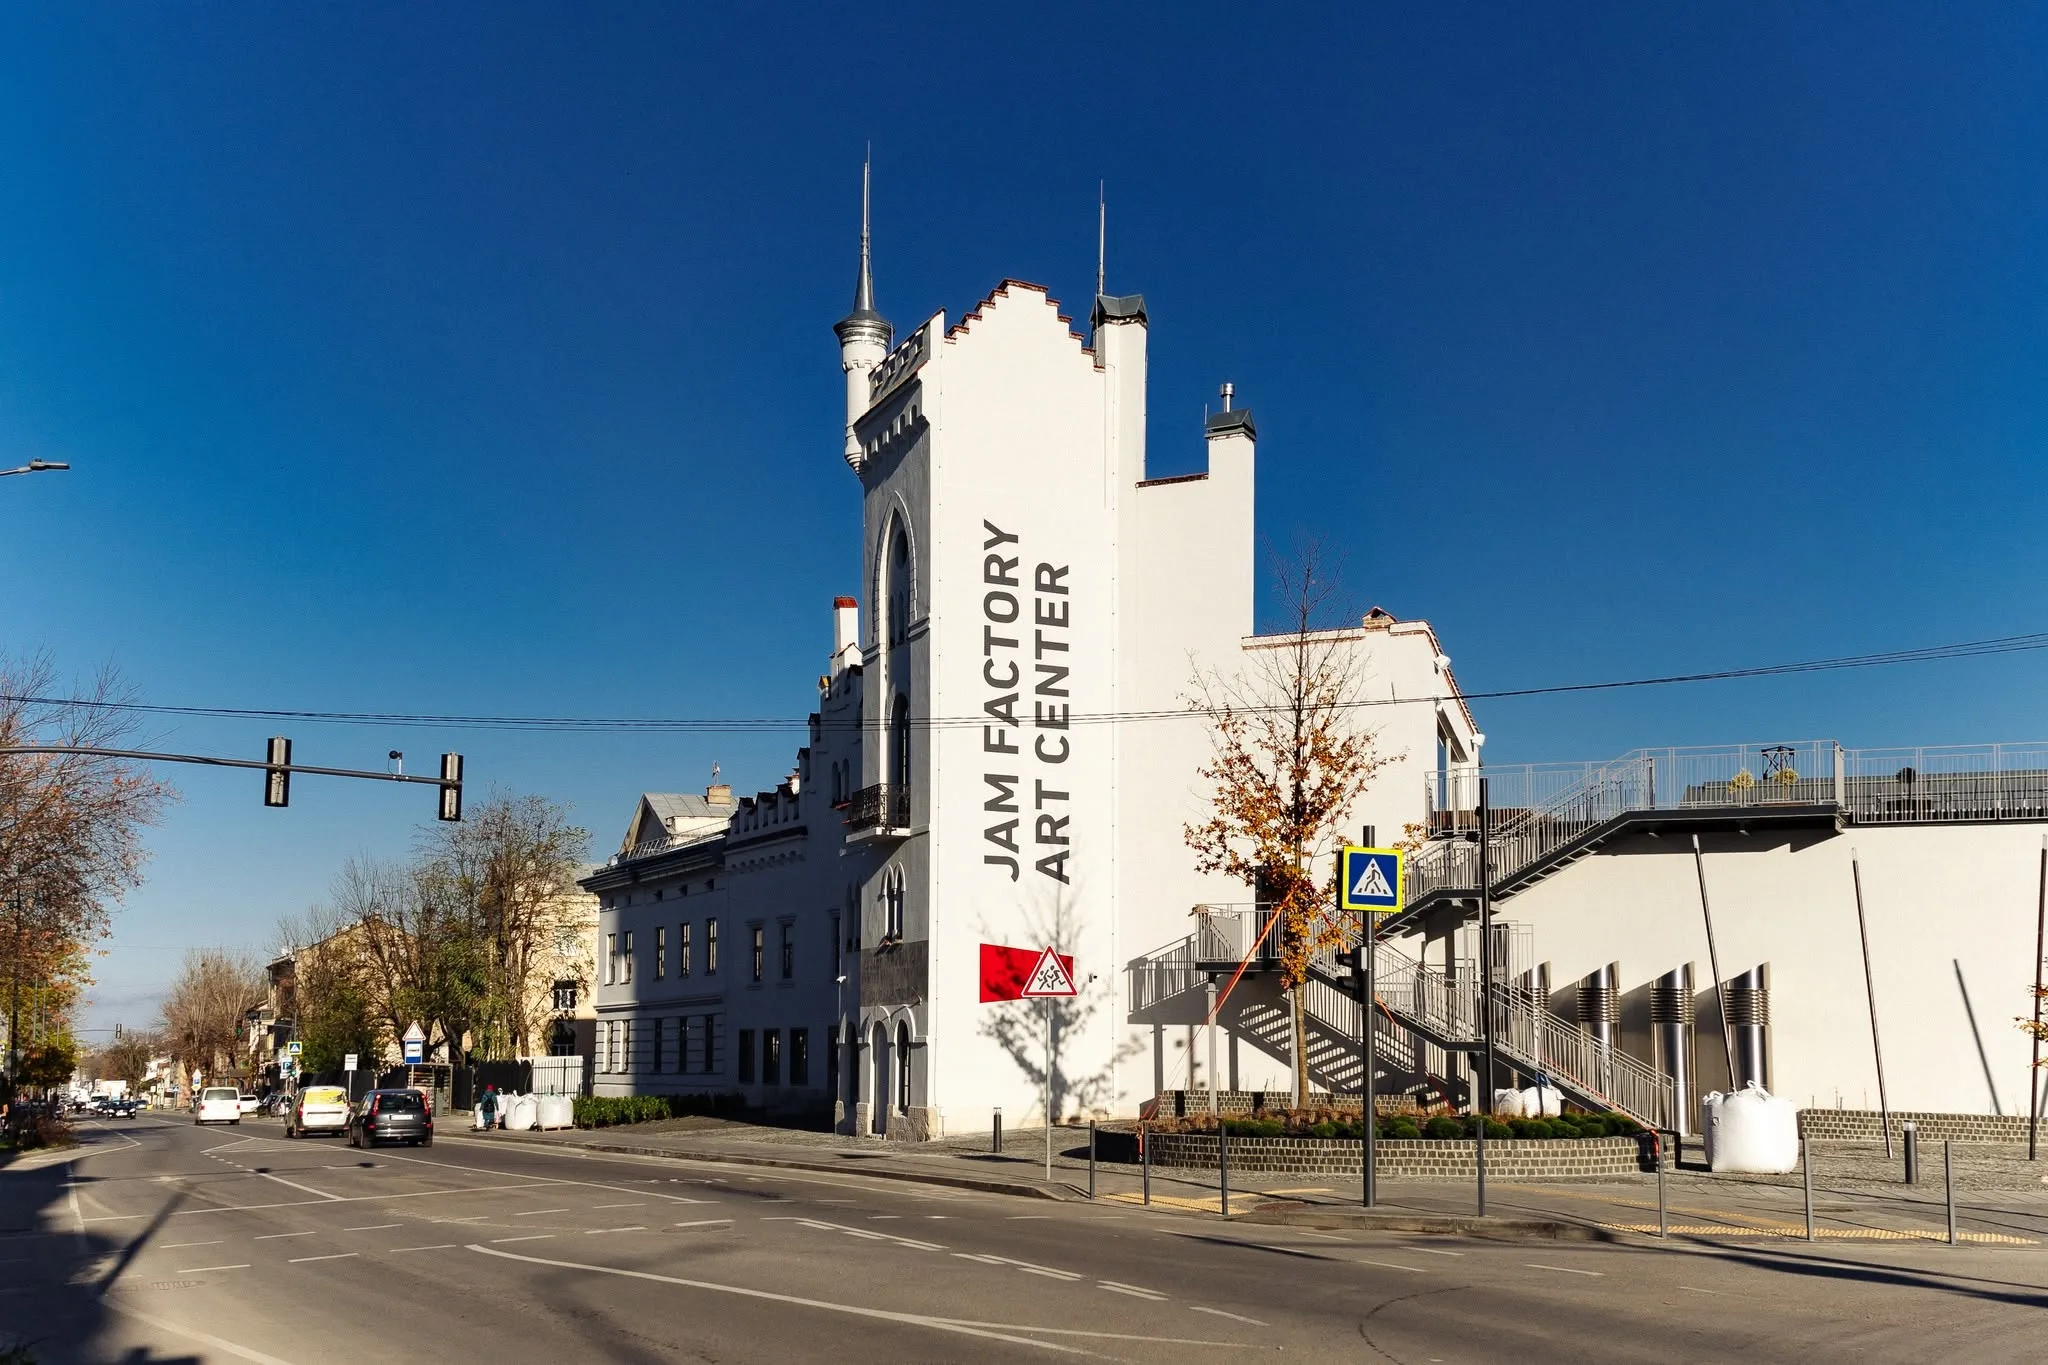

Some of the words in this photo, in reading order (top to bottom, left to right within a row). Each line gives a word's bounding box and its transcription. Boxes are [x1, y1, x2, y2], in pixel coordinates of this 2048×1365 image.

[984, 518, 1019, 754] FACTORY
[1035, 562, 1070, 764] CENTER
[984, 773, 1019, 882] JAM
[1035, 778, 1070, 885] ART
